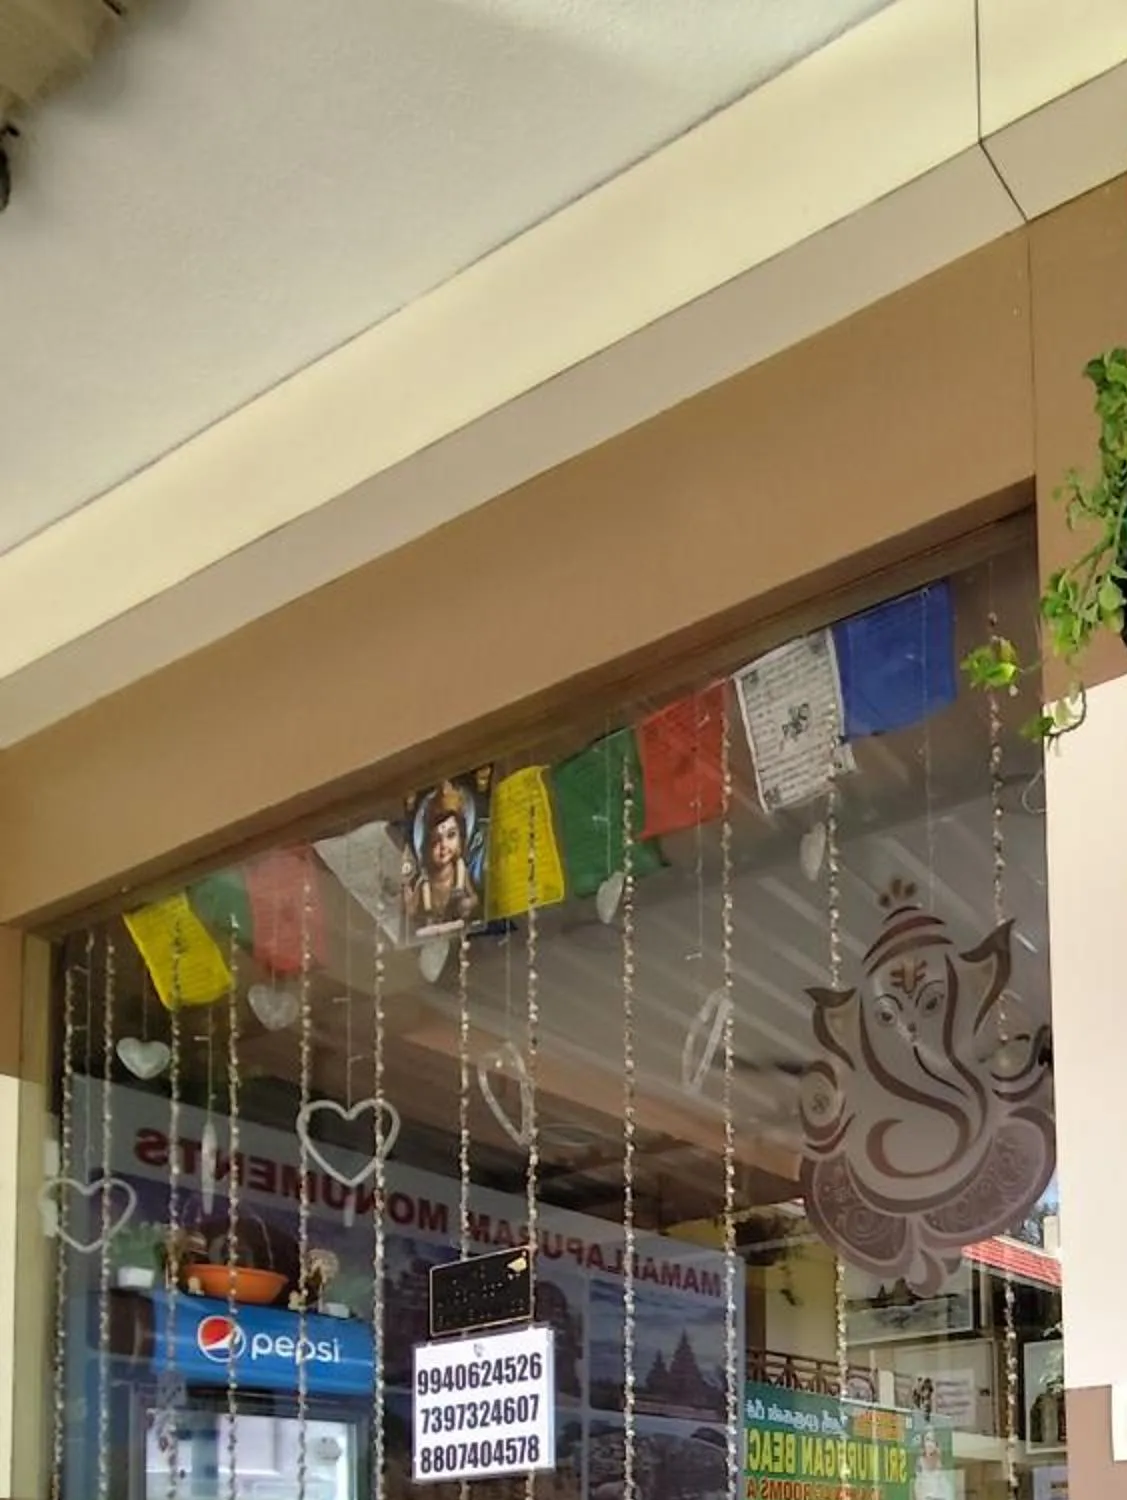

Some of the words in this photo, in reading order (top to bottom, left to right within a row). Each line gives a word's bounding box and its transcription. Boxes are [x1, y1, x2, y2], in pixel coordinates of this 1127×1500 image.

[251, 1332, 340, 1366] pepsi
[417, 1352, 542, 1395] 9940624526
[420, 1394, 540, 1434] 7397324607
[420, 1435, 540, 1473] 8807404578
